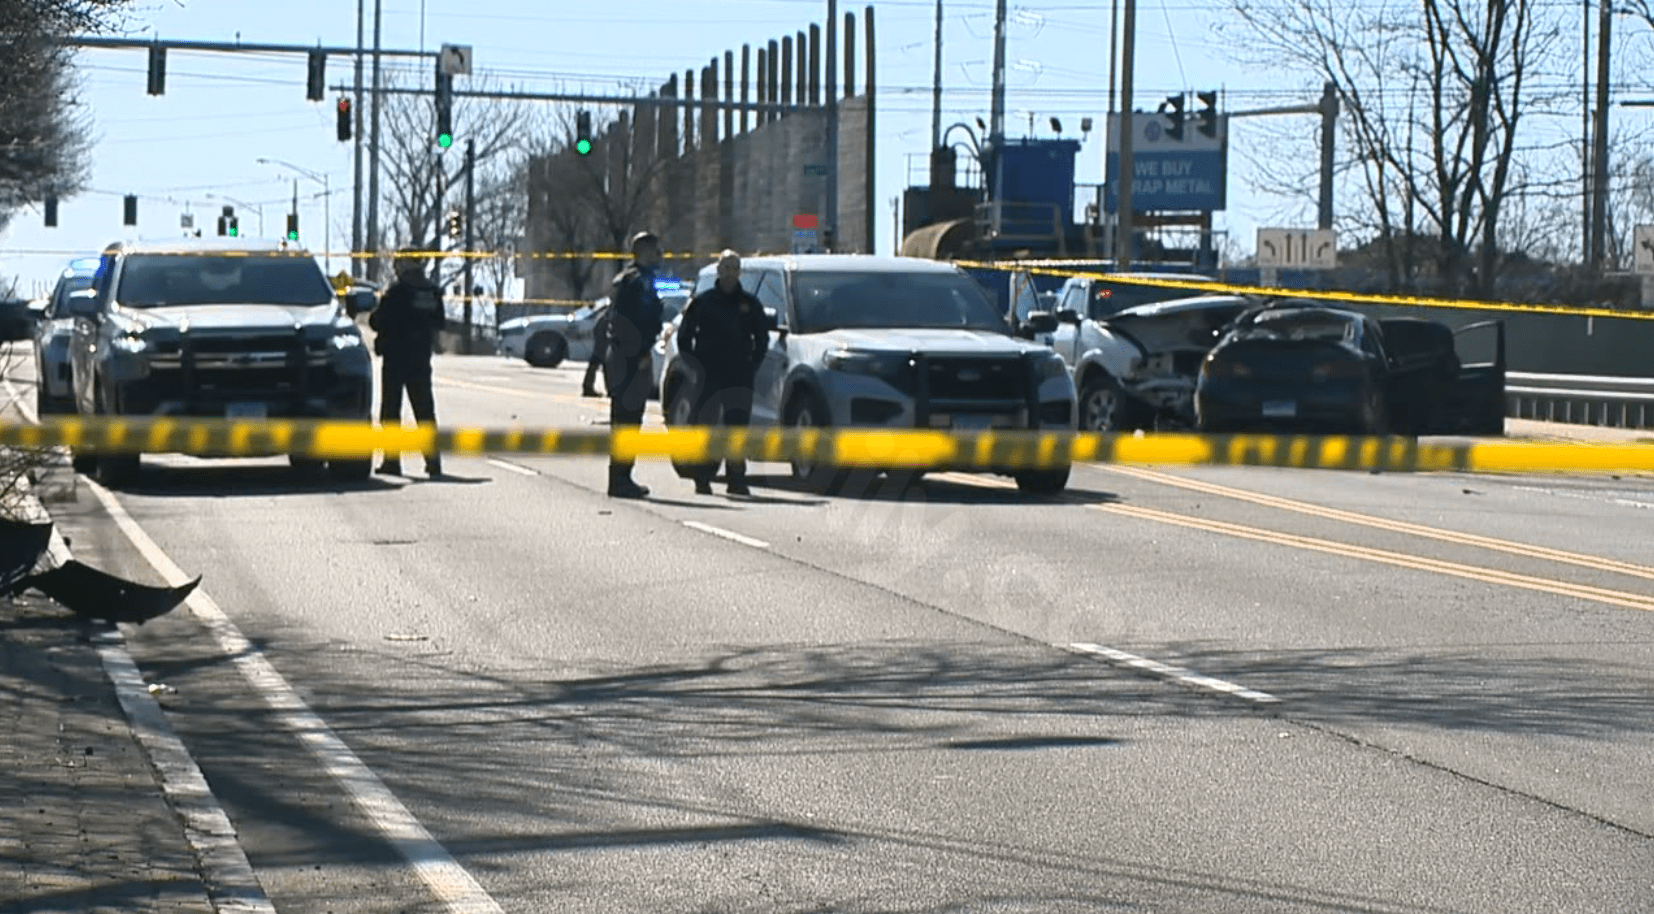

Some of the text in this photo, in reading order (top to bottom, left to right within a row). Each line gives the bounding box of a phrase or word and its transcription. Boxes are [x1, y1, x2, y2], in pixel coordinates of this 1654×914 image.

[1134, 160, 1193, 176] WE BUY
[1111, 178, 1214, 194] SRAP METAL
